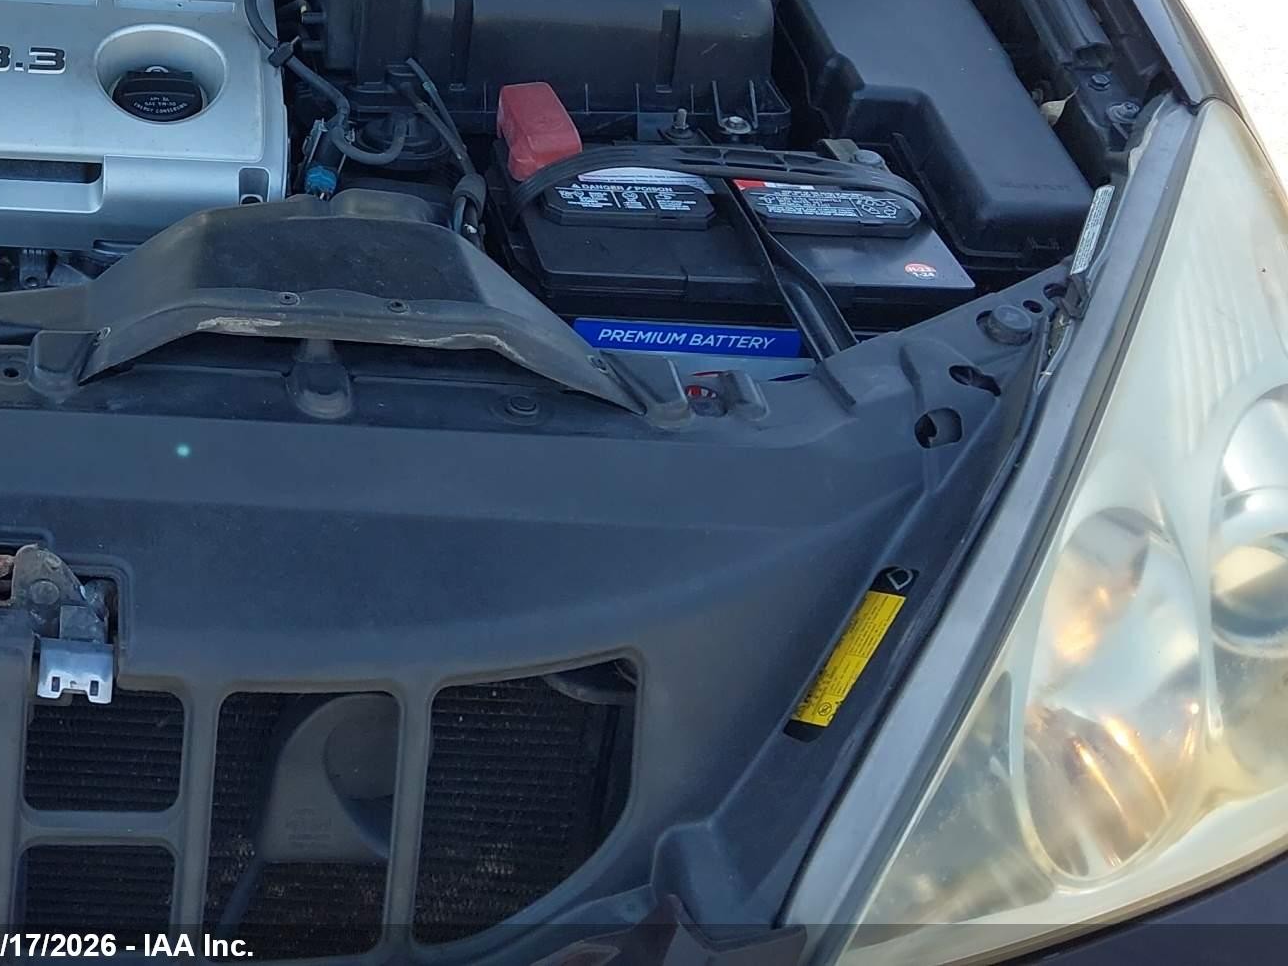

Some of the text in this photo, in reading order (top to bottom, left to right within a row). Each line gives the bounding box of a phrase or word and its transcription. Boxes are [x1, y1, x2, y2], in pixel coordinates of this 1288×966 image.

[581, 184, 624, 192] DANGER
[597, 328, 776, 350] PREMIUM BATTERY
